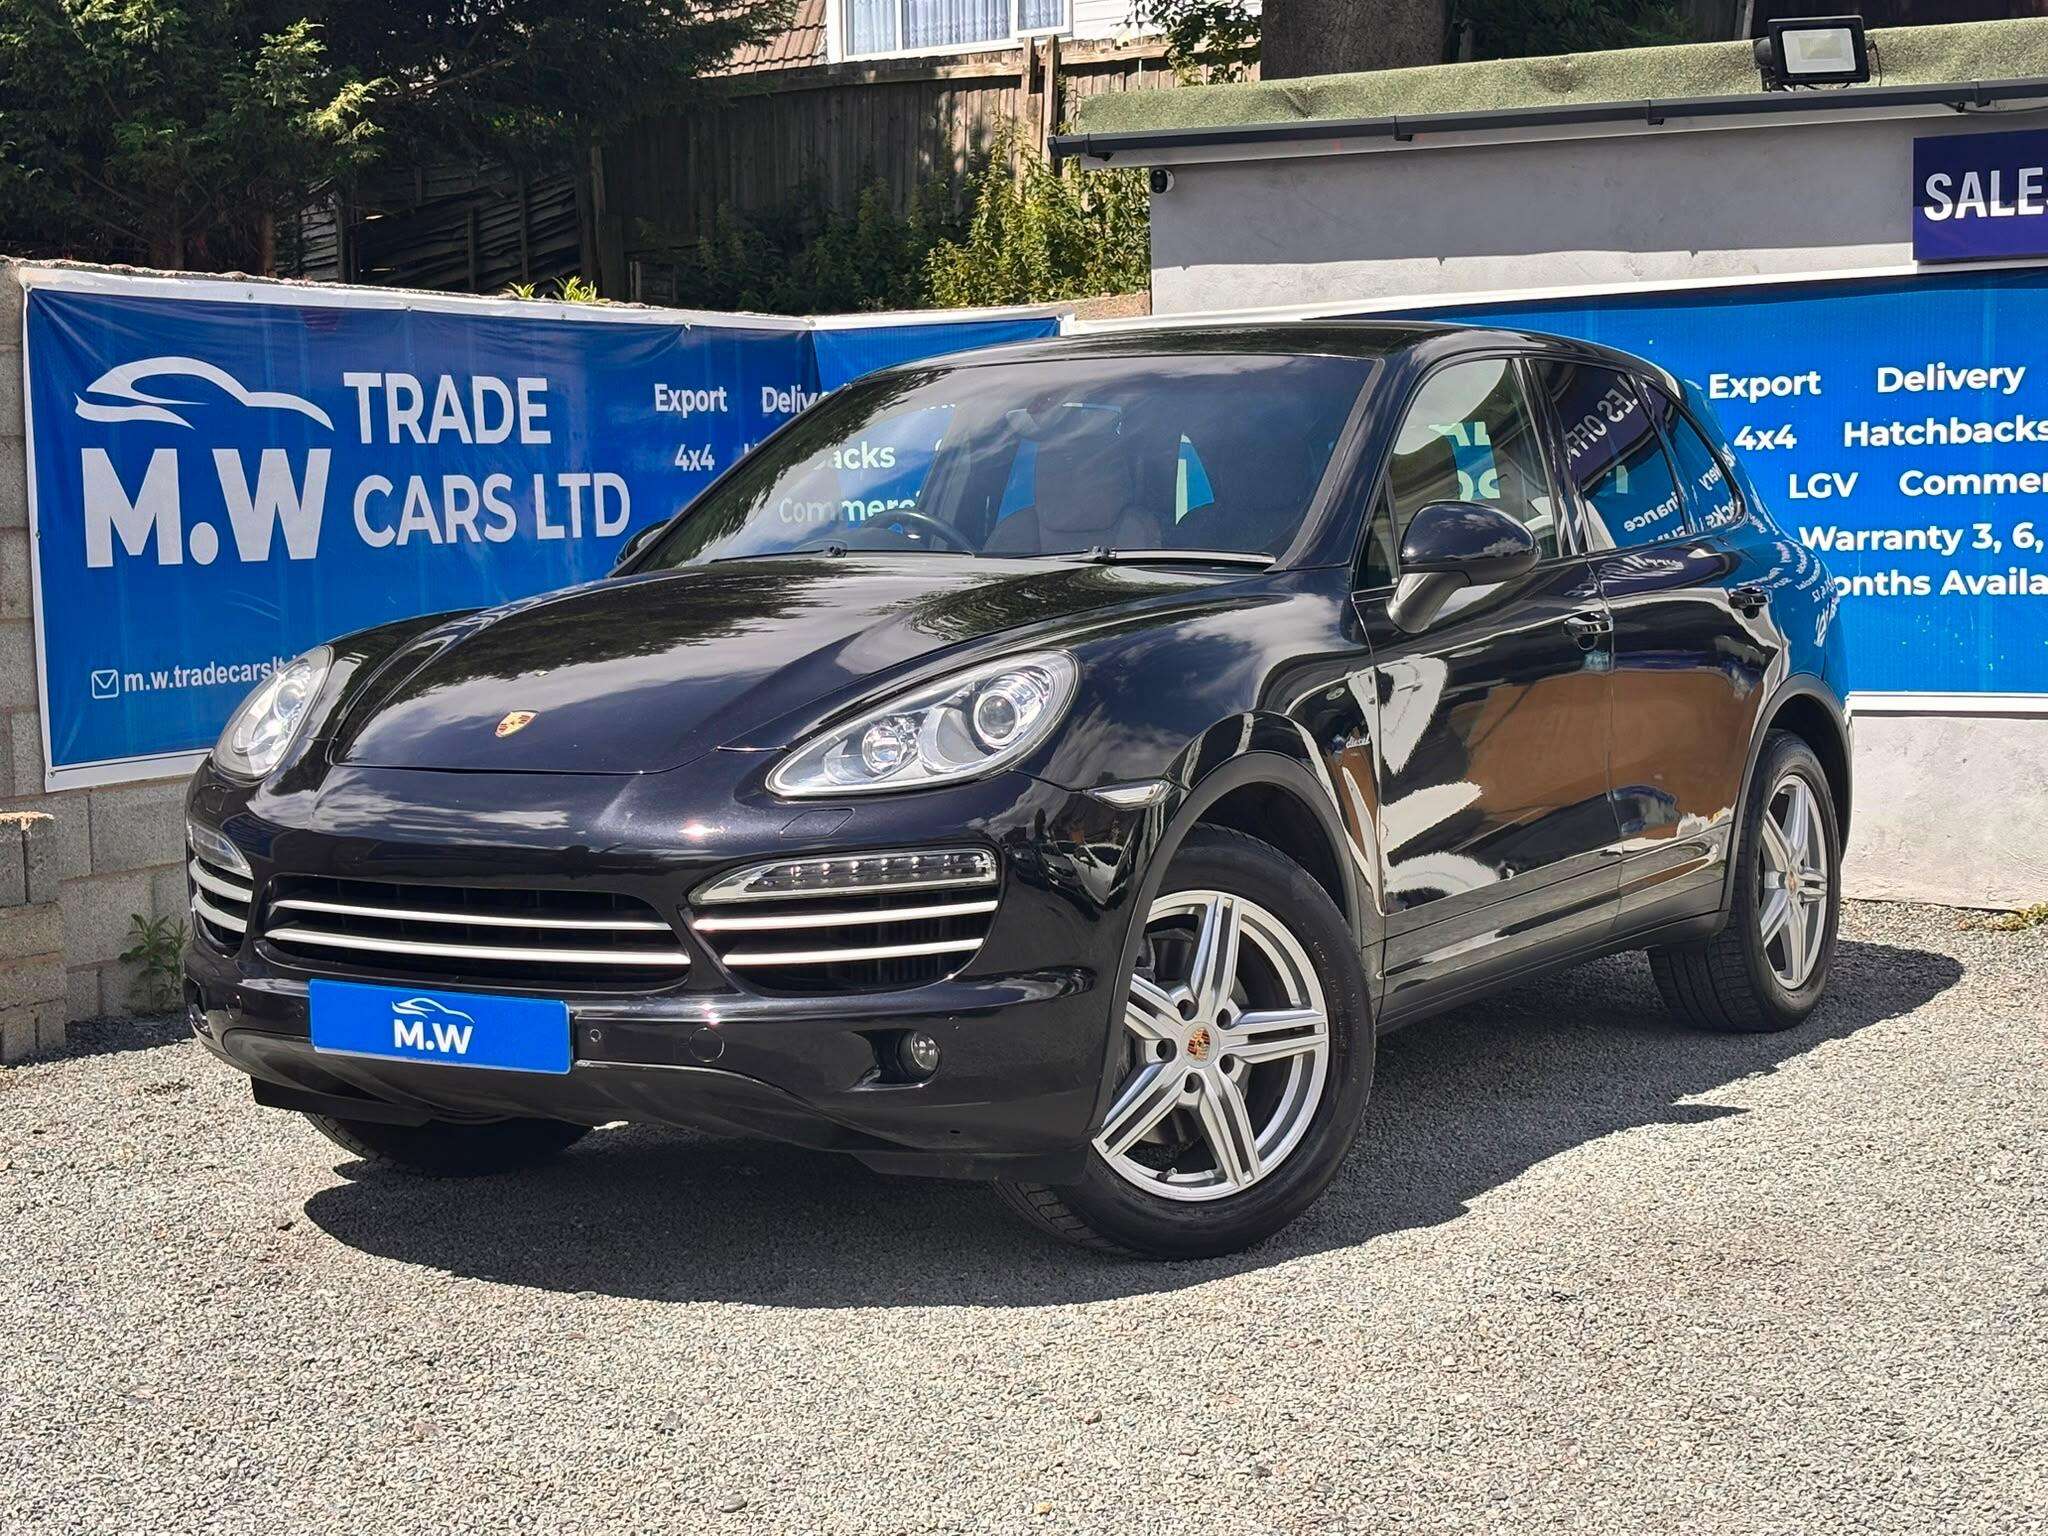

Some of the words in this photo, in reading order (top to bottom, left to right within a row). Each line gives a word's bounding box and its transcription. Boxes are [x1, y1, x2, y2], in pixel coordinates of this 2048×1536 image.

[1923, 166, 2048, 221] SALE
[654, 383, 728, 418] Export
[1709, 372, 1821, 404] Export
[1877, 362, 2026, 395] Delivery
[343, 372, 552, 444] TRADE
[1733, 424, 1797, 452] 4x4
[1844, 414, 2048, 446] Hatchbacks
[674, 443, 716, 471] 4x4
[1789, 472, 1859, 499] LGV
[81, 447, 332, 568] M.W
[353, 473, 517, 548] CARS
[533, 472, 632, 539] LTD
[1798, 525, 1964, 557] Warranty
[1972, 523, 2002, 554] 3,
[2012, 522, 2044, 553] 6,
[1831, 569, 1932, 597] onths
[1939, 566, 2048, 596] Availa
[393, 1018, 474, 1056] M.W
